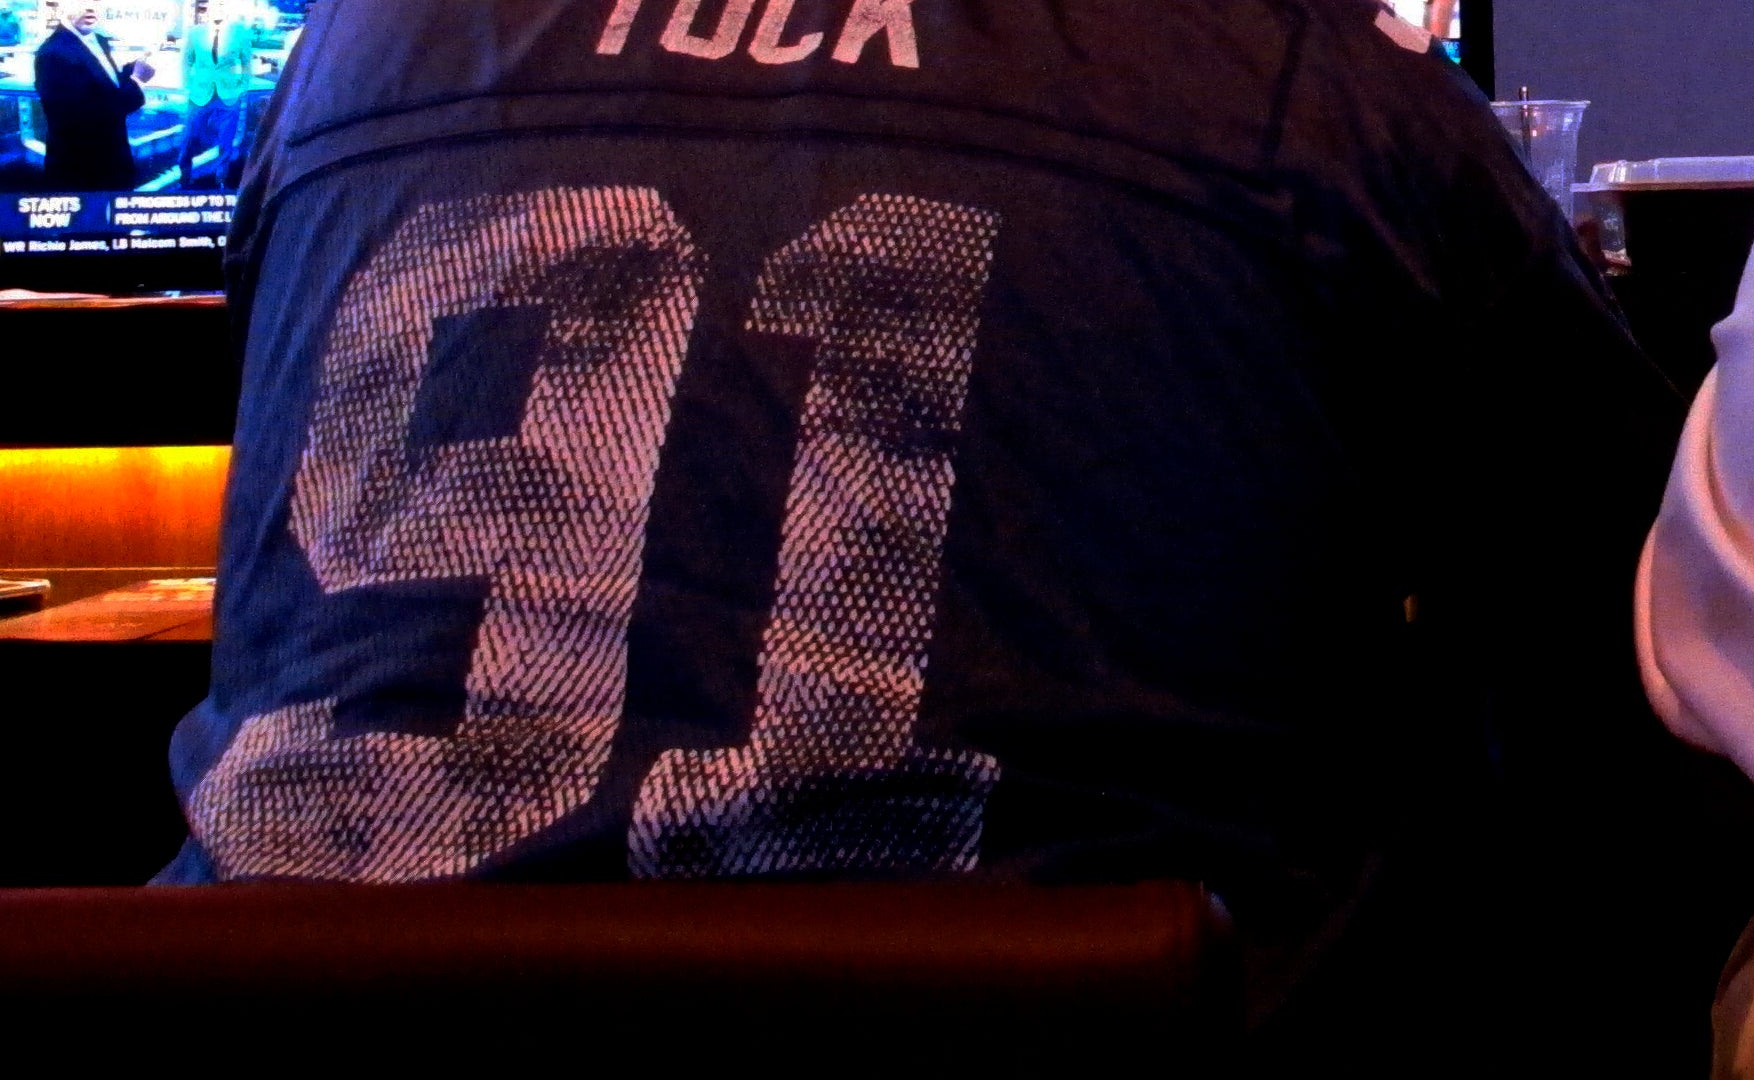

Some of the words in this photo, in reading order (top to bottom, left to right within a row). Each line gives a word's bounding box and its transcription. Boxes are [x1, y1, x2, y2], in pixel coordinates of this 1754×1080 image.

[18, 197, 81, 213] STARTS
[191, 195, 208, 207] UP
[209, 195, 224, 207] TO
[30, 213, 71, 228] NOW
[115, 212, 149, 225] FROM
[150, 211, 200, 224] AROUND
[202, 210, 224, 223] THE
[3, 241, 26, 253] WR
[179, 236, 215, 248] Smith,
[187, 185, 1000, 883] 91
